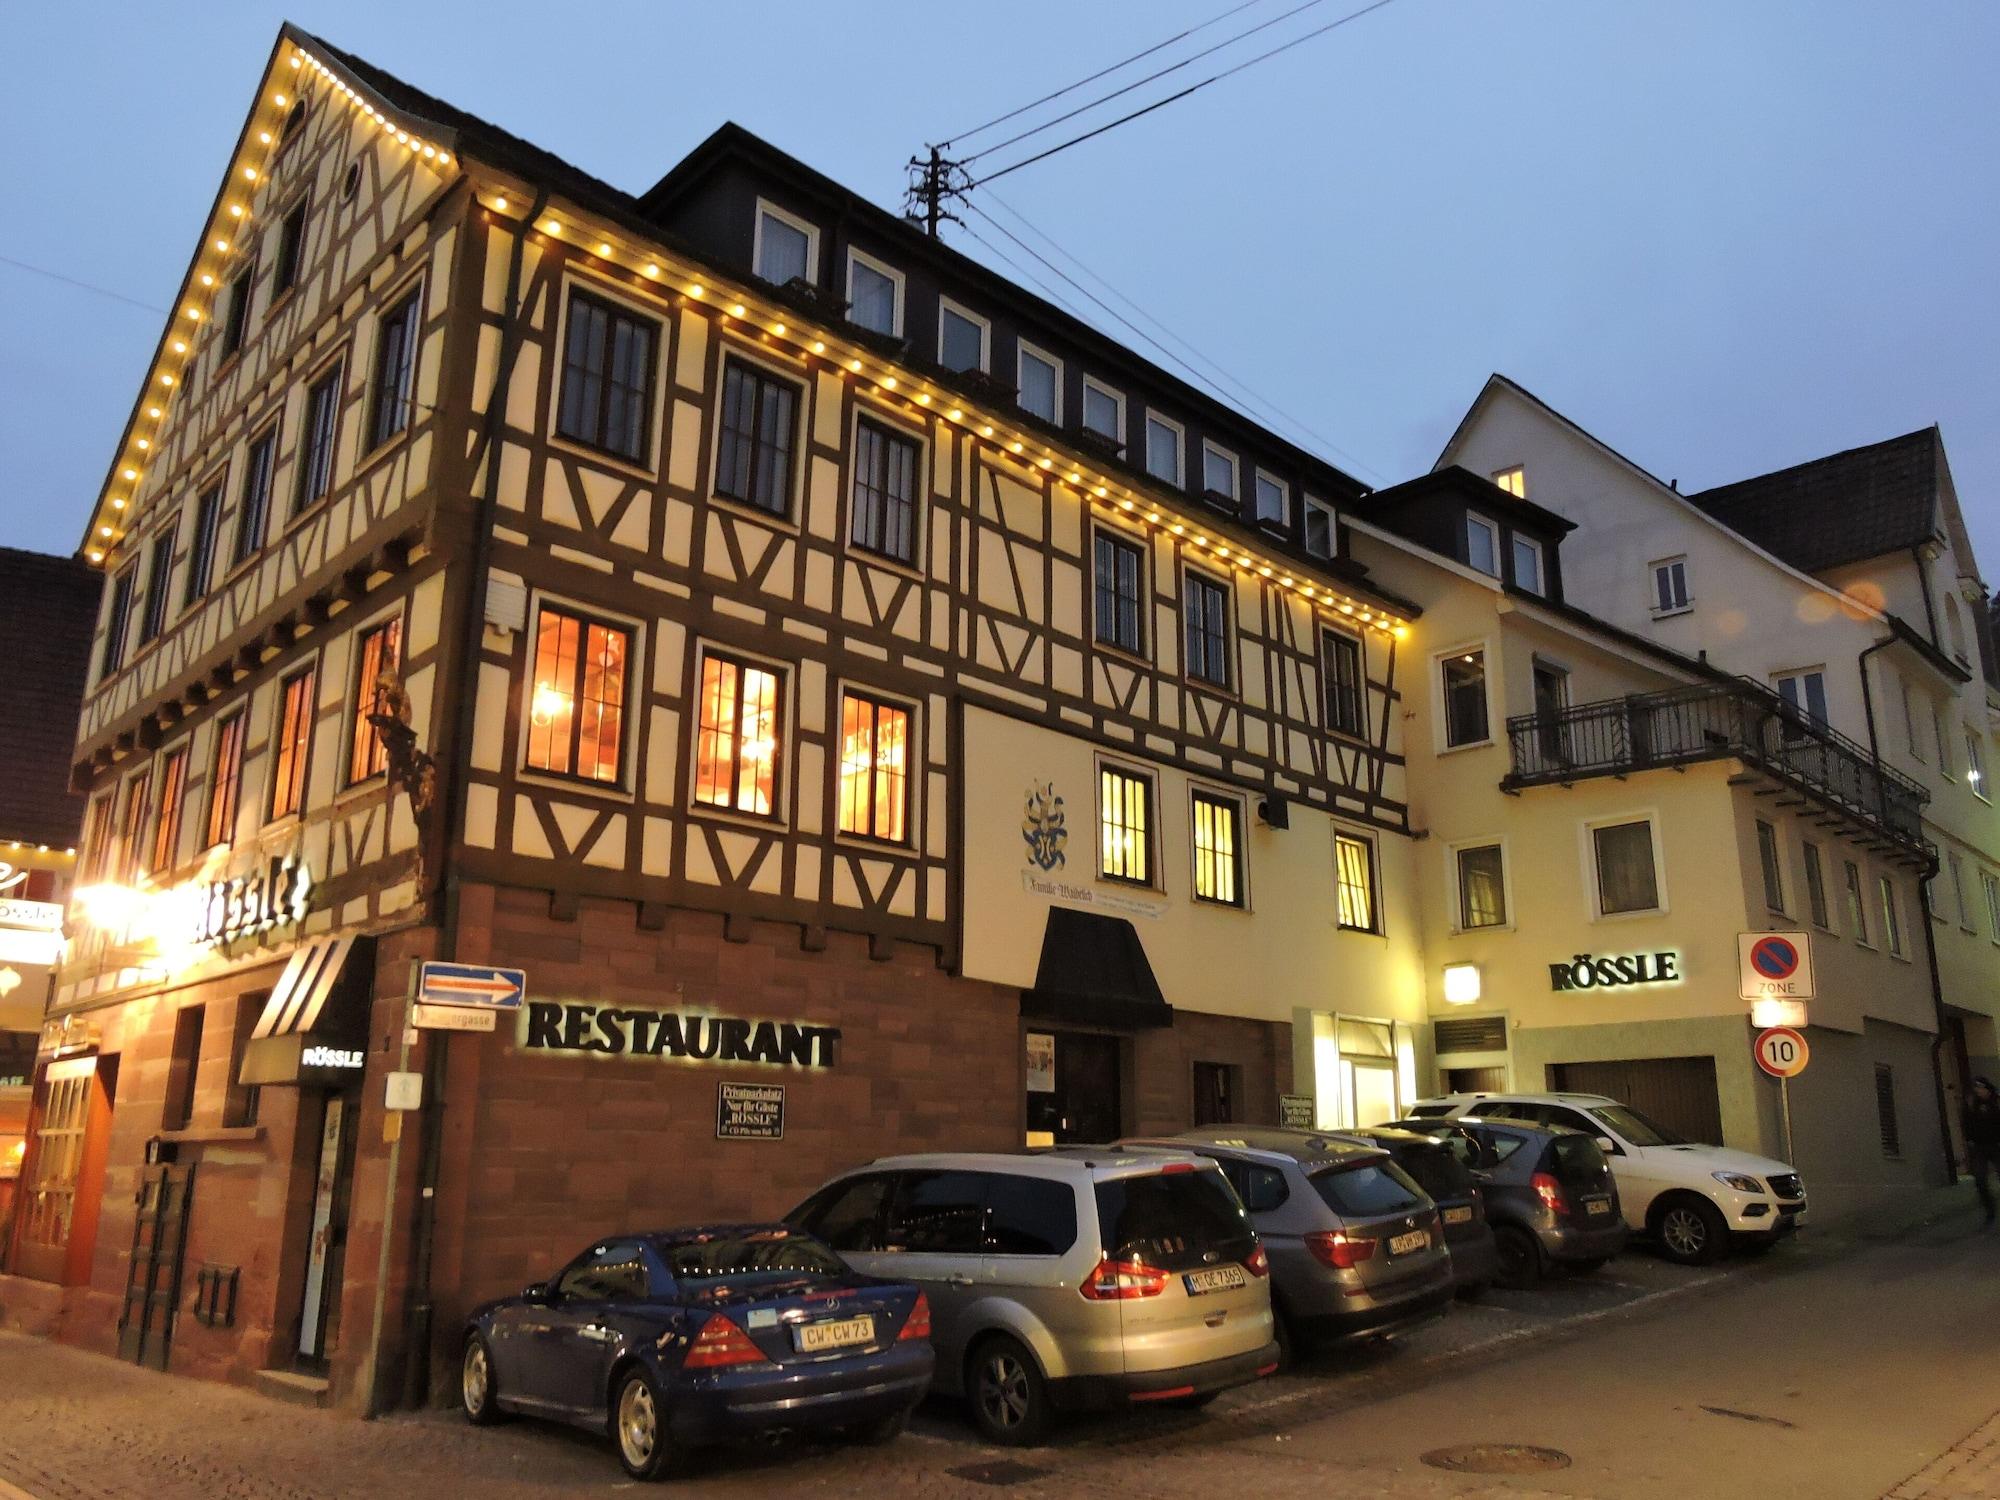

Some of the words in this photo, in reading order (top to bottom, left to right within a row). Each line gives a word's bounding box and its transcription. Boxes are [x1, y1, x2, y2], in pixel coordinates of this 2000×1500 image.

[1549, 953, 1679, 991] RÖSSLE
[1758, 982, 1797, 995] ZONE
[526, 1001, 843, 1067] RESTAURANT
[302, 1046, 364, 1068] RÖSSLE
[1768, 1041, 1794, 1062] 10
[726, 1100, 742, 1111] Nur
[806, 1328, 825, 1345] CW
[832, 1325, 850, 1342] CW
[852, 1321, 869, 1338] 73
